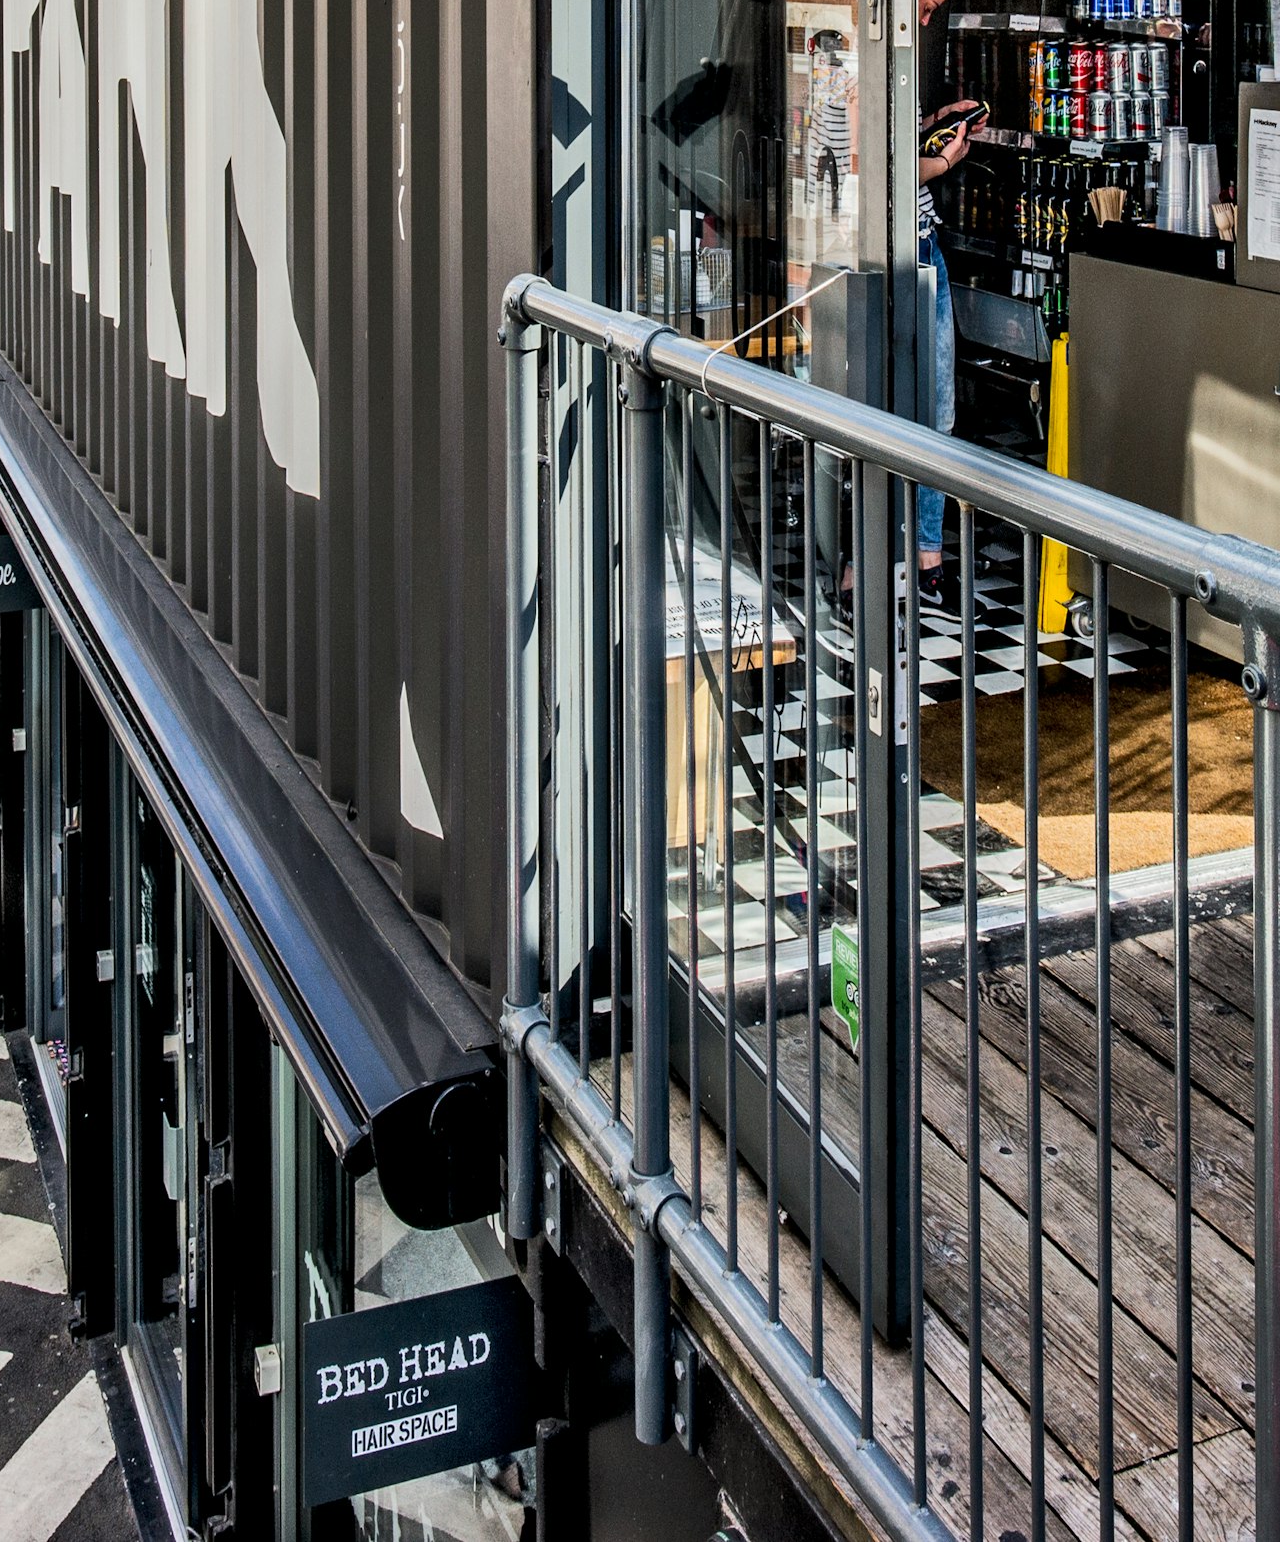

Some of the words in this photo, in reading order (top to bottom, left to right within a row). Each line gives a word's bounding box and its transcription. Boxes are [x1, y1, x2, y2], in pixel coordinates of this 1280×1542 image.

[1259, 120, 1277, 129] Hackney
[317, 1357, 389, 1405] BED
[399, 1332, 491, 1384] HEAD
[385, 1386, 423, 1410] TIGI
[354, 1424, 395, 1454] HAIR
[399, 1408, 456, 1441] SPACE
